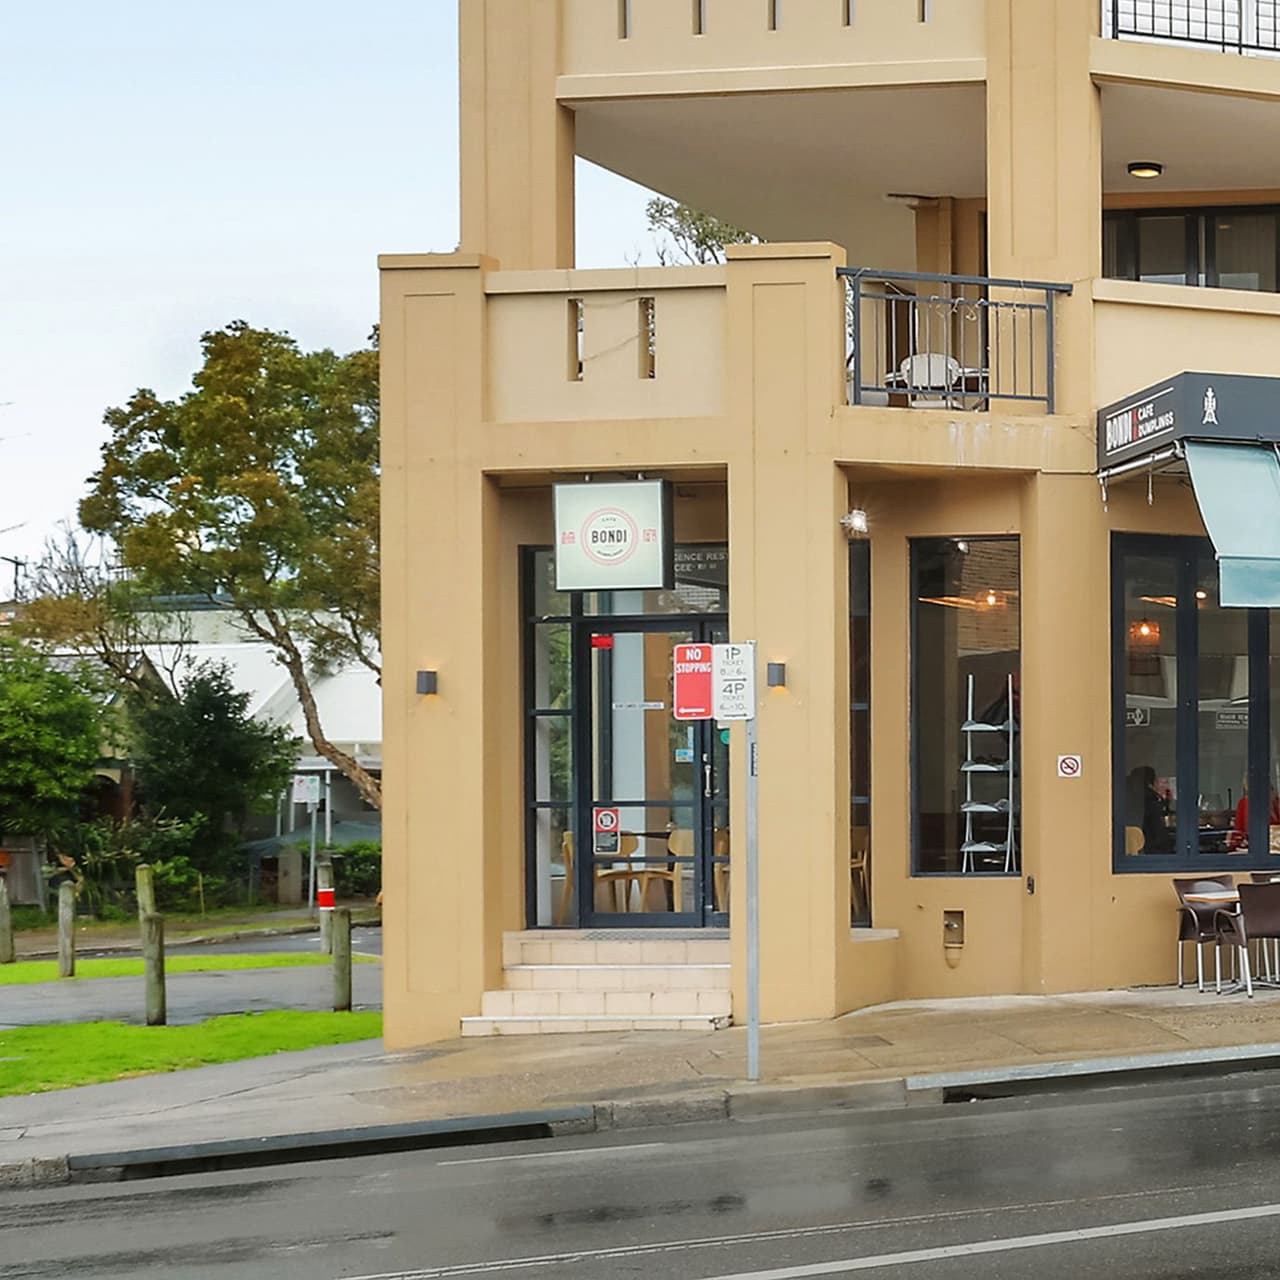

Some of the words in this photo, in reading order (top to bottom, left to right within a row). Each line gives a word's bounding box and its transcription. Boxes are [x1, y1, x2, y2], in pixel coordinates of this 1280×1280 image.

[1138, 403, 1154, 421] CAFE
[1106, 410, 1132, 451] BONDI
[1138, 411, 1174, 438] DUMPLINGS
[592, 529, 627, 544] BONDI
[686, 648, 702, 660] NO
[726, 647, 741, 660] 1P
[676, 663, 712, 673] STOPPING
[723, 682, 745, 694] 4P
